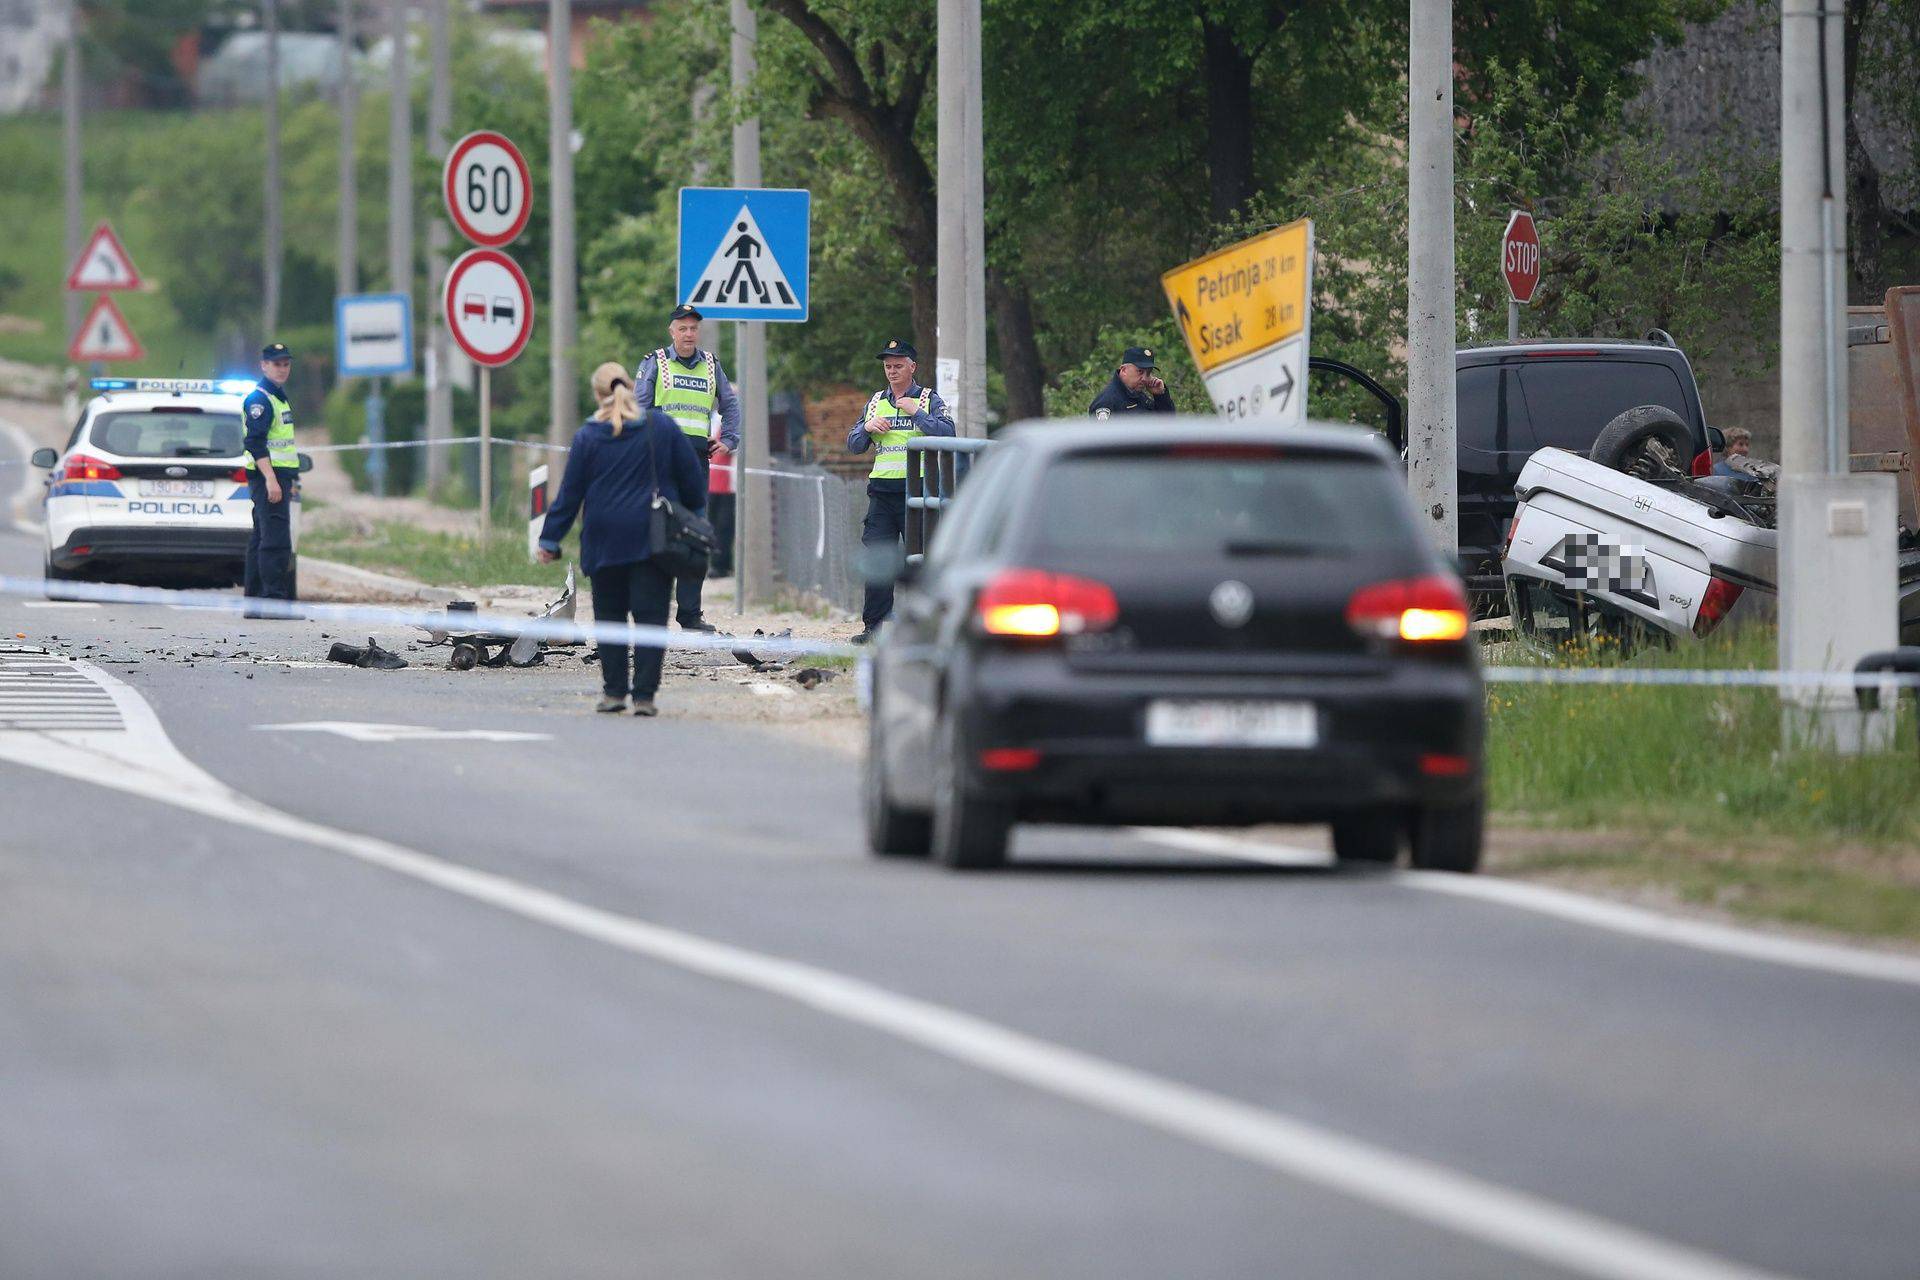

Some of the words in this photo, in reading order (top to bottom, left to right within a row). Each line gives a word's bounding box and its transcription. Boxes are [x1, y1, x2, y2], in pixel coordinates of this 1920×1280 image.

[468, 163, 511, 215] 60
[1507, 240, 1538, 275] STOP
[1198, 261, 1260, 307] Petrinja
[1280, 255, 1296, 275] km
[1200, 313, 1243, 354] Sisak
[1279, 303, 1294, 323] km
[141, 381, 209, 390] POLICIJA
[674, 377, 707, 389] POLICIJA
[129, 502, 223, 515] POLICIJA
[1634, 496, 1653, 512] HR
